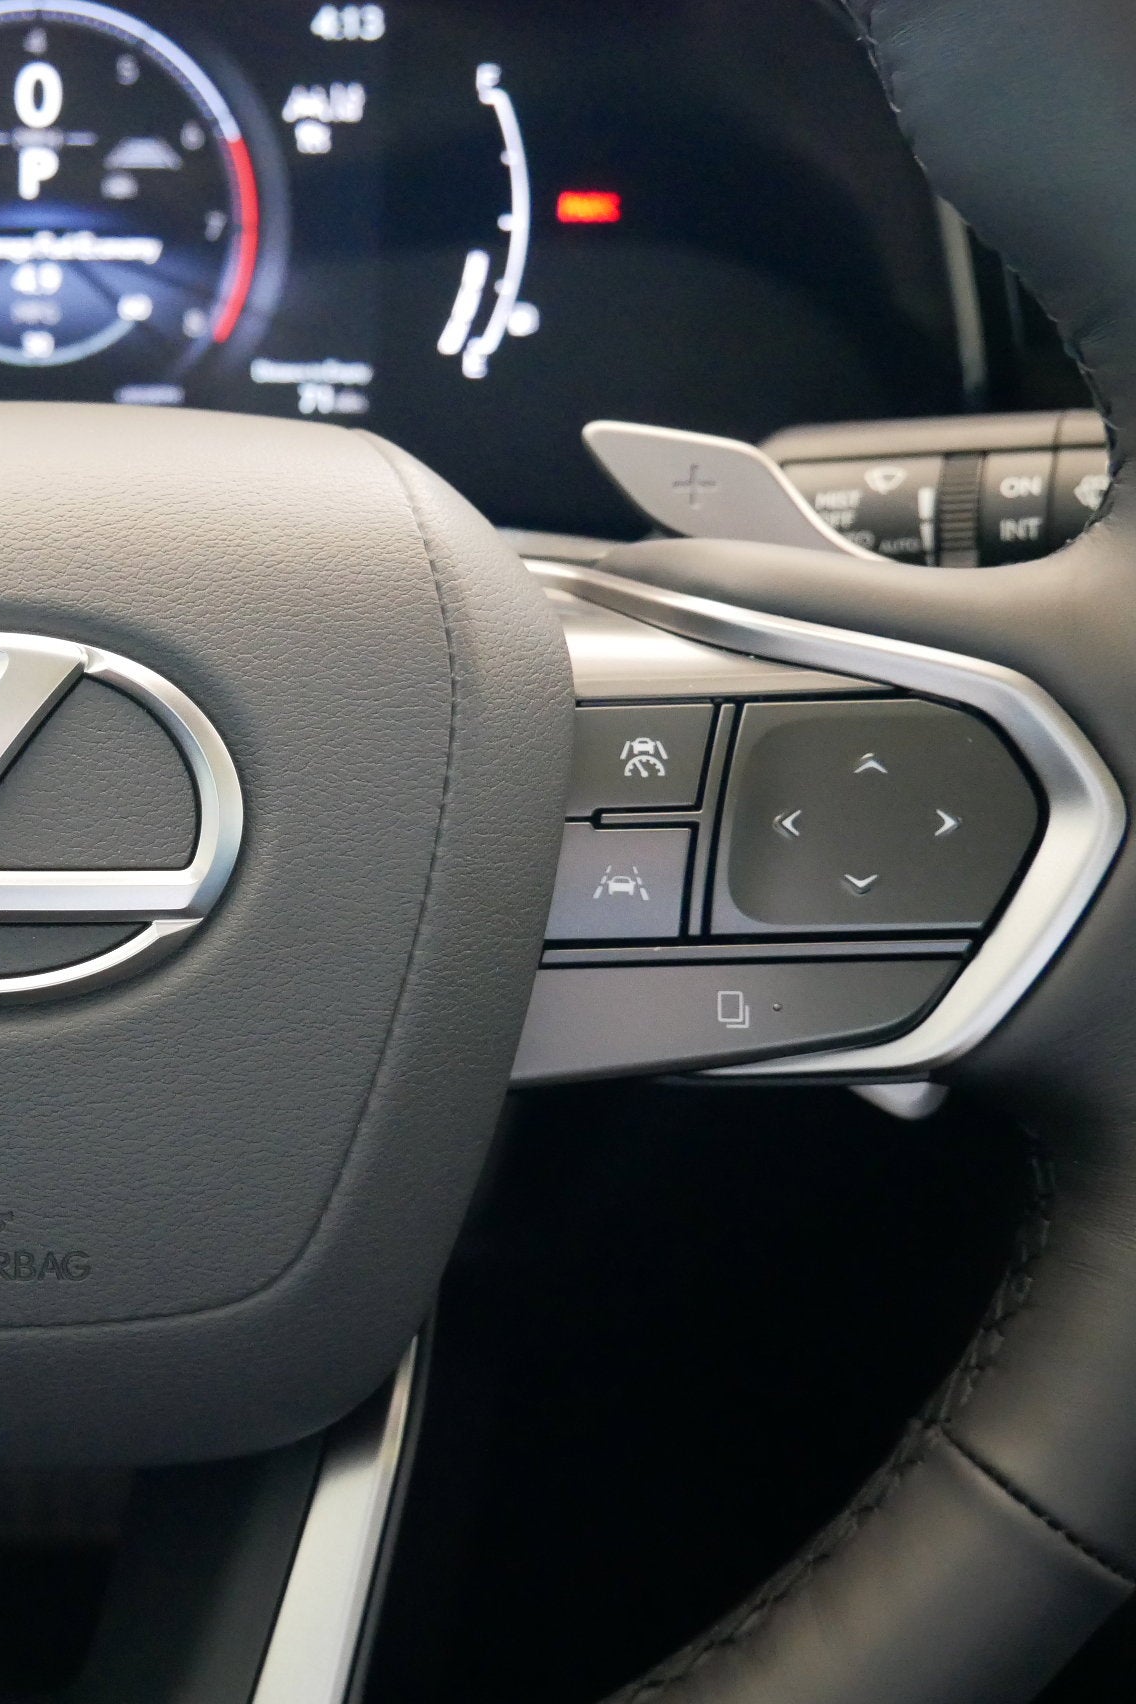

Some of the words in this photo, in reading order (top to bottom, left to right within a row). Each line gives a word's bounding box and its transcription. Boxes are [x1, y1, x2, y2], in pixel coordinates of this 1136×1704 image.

[13, 61, 63, 128] 0
[18, 146, 59, 200] P
[999, 476, 1043, 499] ON
[999, 517, 1043, 542] INT
